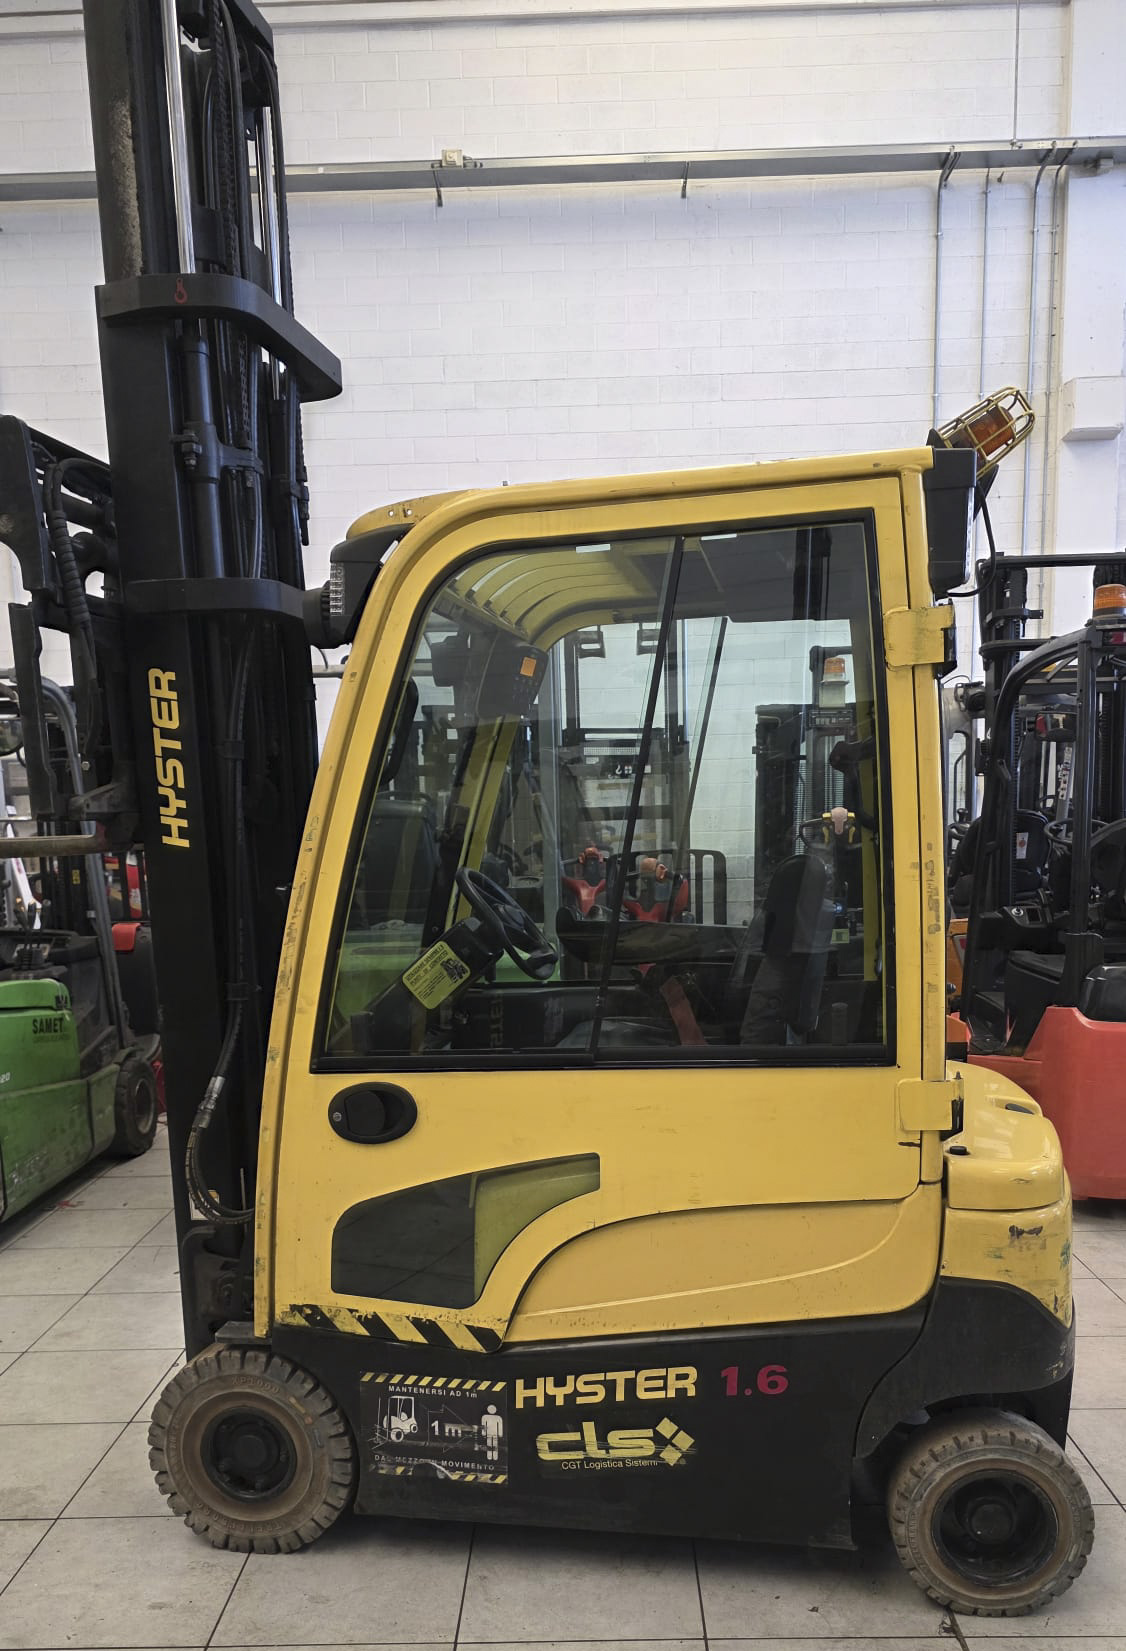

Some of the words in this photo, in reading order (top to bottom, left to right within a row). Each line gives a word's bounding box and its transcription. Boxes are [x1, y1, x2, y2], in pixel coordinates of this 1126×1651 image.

[148, 667, 190, 848] HYSTER
[32, 1017, 64, 1034] SAMET
[515, 1366, 698, 1409] HYSTER
[721, 1365, 789, 1397] 1.6
[388, 1385, 446, 1396] MANTENERSI
[431, 1420, 440, 1436] 1
[444, 1423, 462, 1437] m
[441, 1460, 495, 1470] MOVIMENTO
[561, 1461, 581, 1470] CGT
[584, 1460, 624, 1470] Logistica
[625, 1459, 658, 1468] Sistemi
